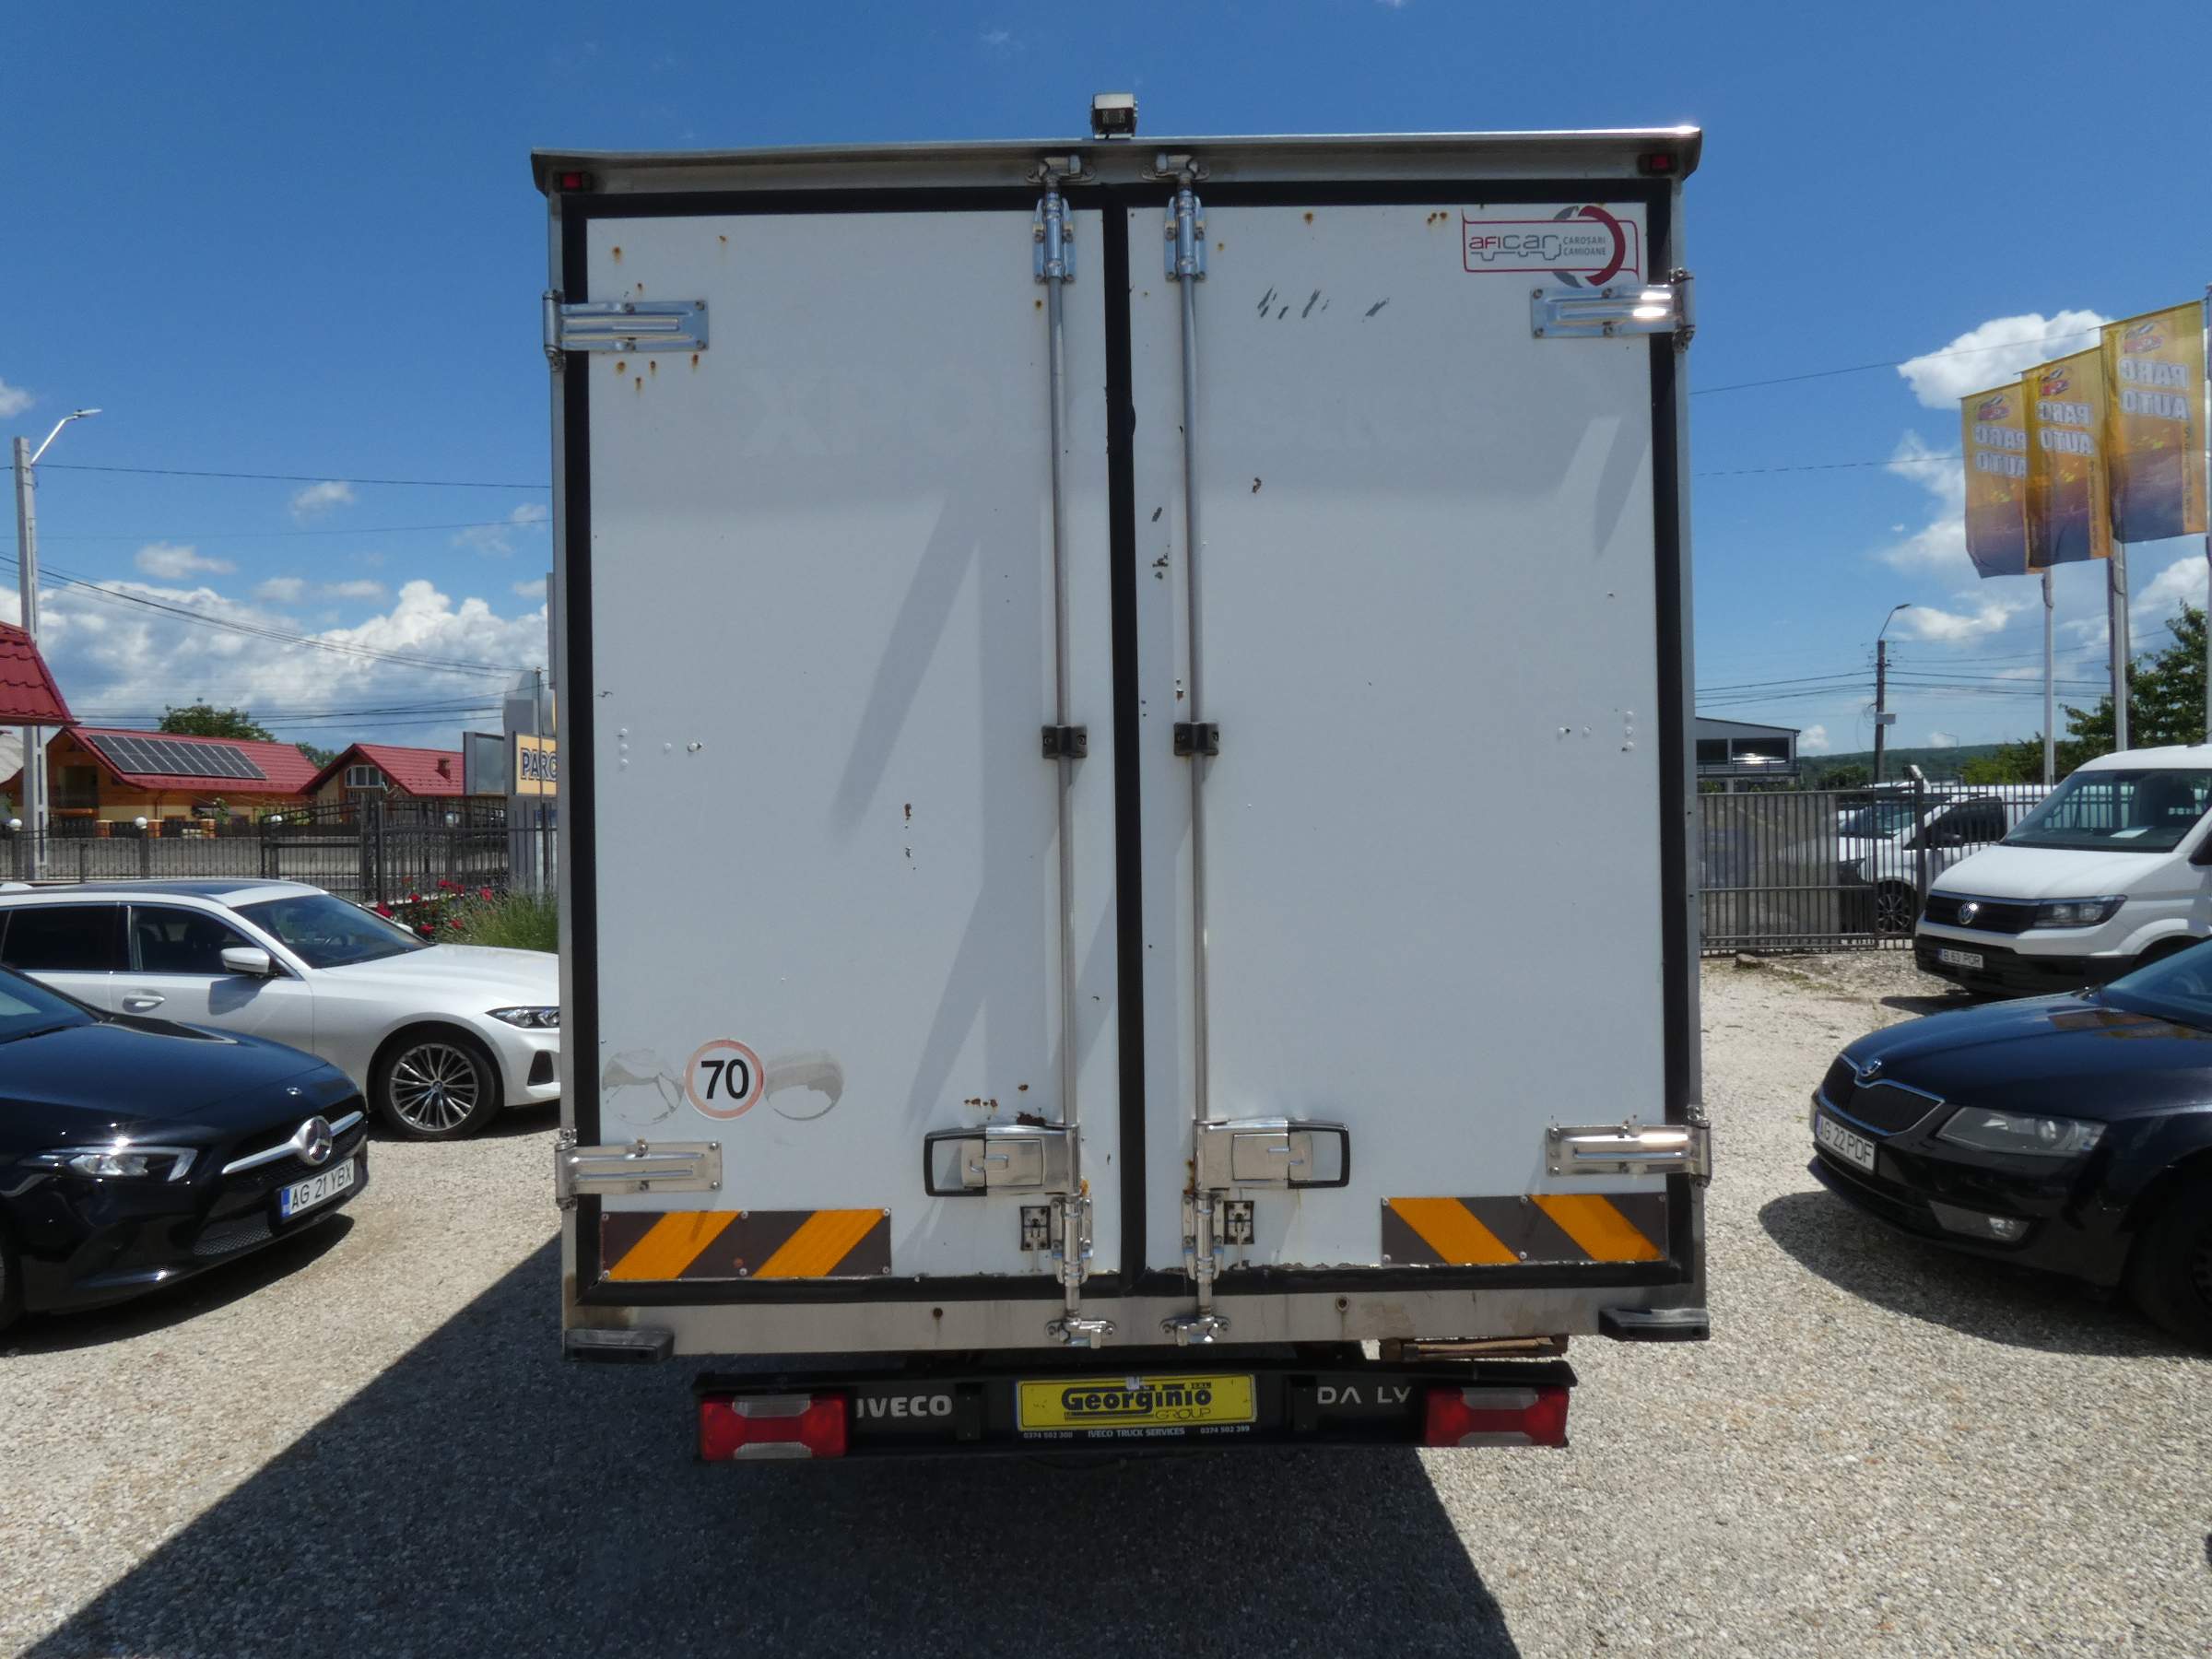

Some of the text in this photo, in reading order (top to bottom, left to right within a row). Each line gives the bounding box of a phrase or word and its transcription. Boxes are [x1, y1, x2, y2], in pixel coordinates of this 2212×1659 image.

[700, 1058, 749, 1100] 70
[291, 1162, 352, 1209] AG 21 YBX
[855, 1394, 953, 1418] IVECO
[1061, 1383, 1212, 1416] Georginio
[1155, 1407, 1212, 1420] GROUP
[1088, 1428, 1185, 1438] IVECO TRUCK SERVICES
